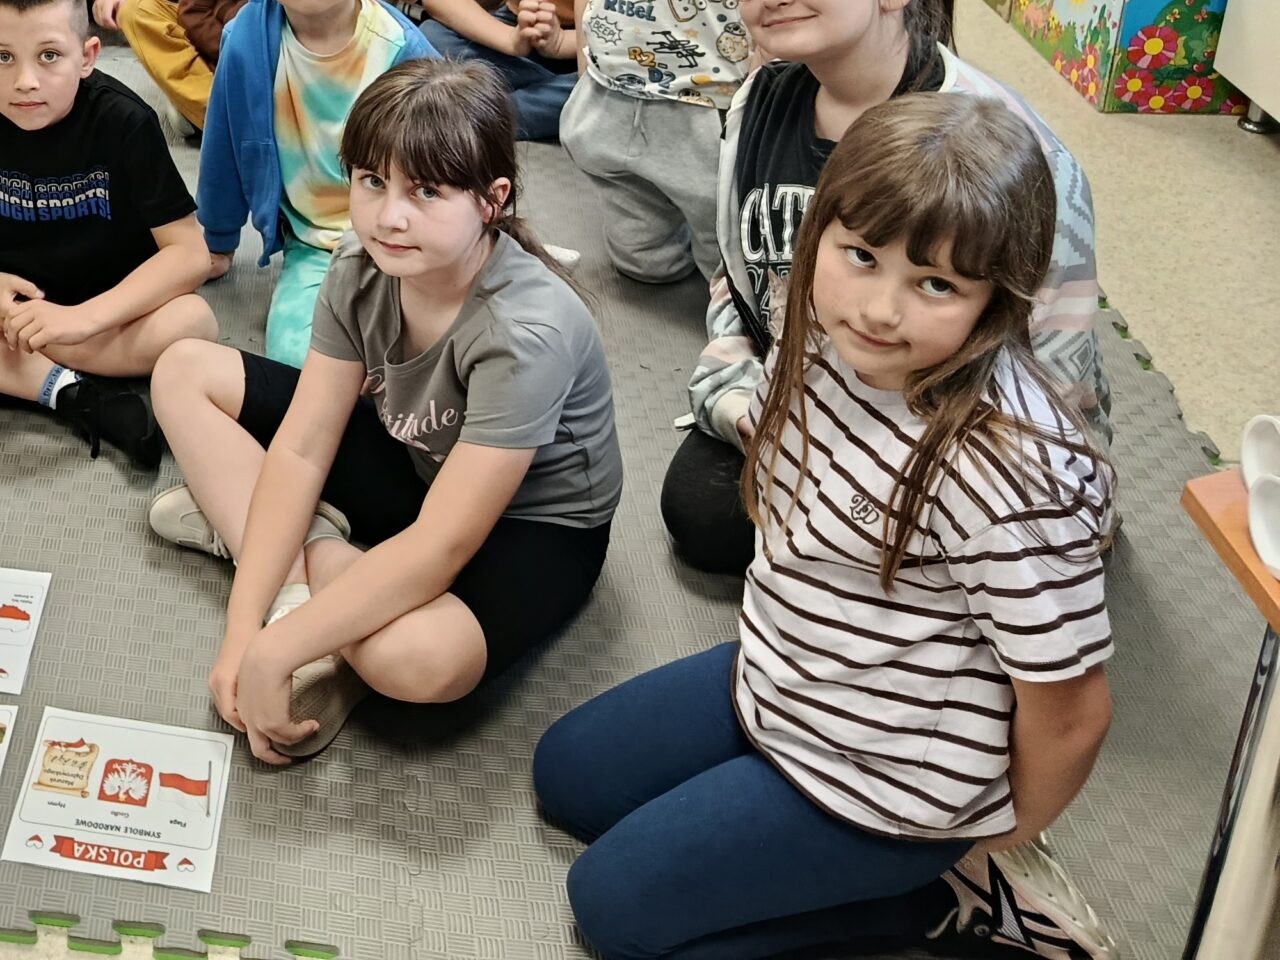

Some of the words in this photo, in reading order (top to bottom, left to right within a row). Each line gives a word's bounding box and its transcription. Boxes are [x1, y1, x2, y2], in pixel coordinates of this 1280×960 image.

[38, 197, 112, 221] SPORTS!
[740, 183, 816, 262] CAT
[50, 778, 74, 787] Mazurek
[75, 819, 121, 832] NARODOWE
[170, 819, 186, 827] Flaga
[124, 826, 161, 839] SYMBOLE
[73, 842, 145, 868] POLSKA
